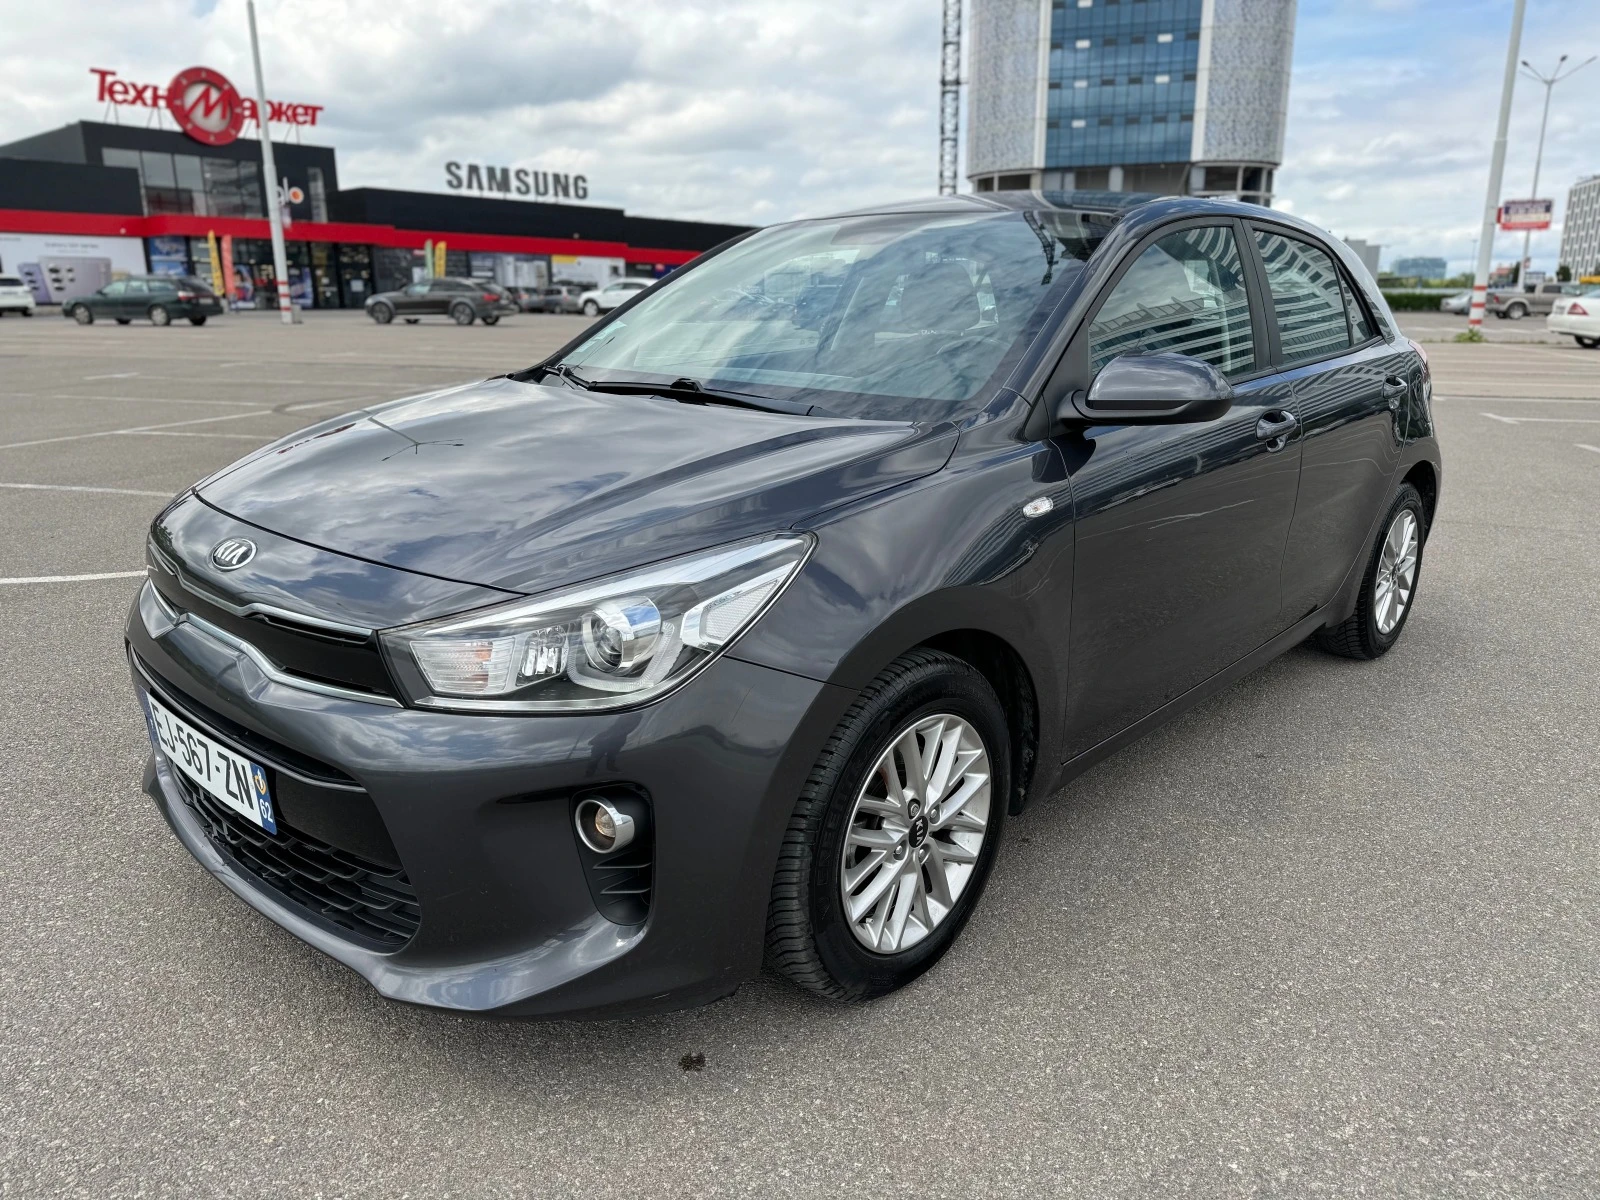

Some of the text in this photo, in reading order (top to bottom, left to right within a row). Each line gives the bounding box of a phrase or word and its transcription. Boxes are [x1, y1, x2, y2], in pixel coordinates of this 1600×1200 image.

[445, 161, 588, 200] SAMSUNG
[150, 701, 255, 811] EJ-567-ZN
[259, 798, 274, 823] 62
[915, 818, 924, 846] KIA
